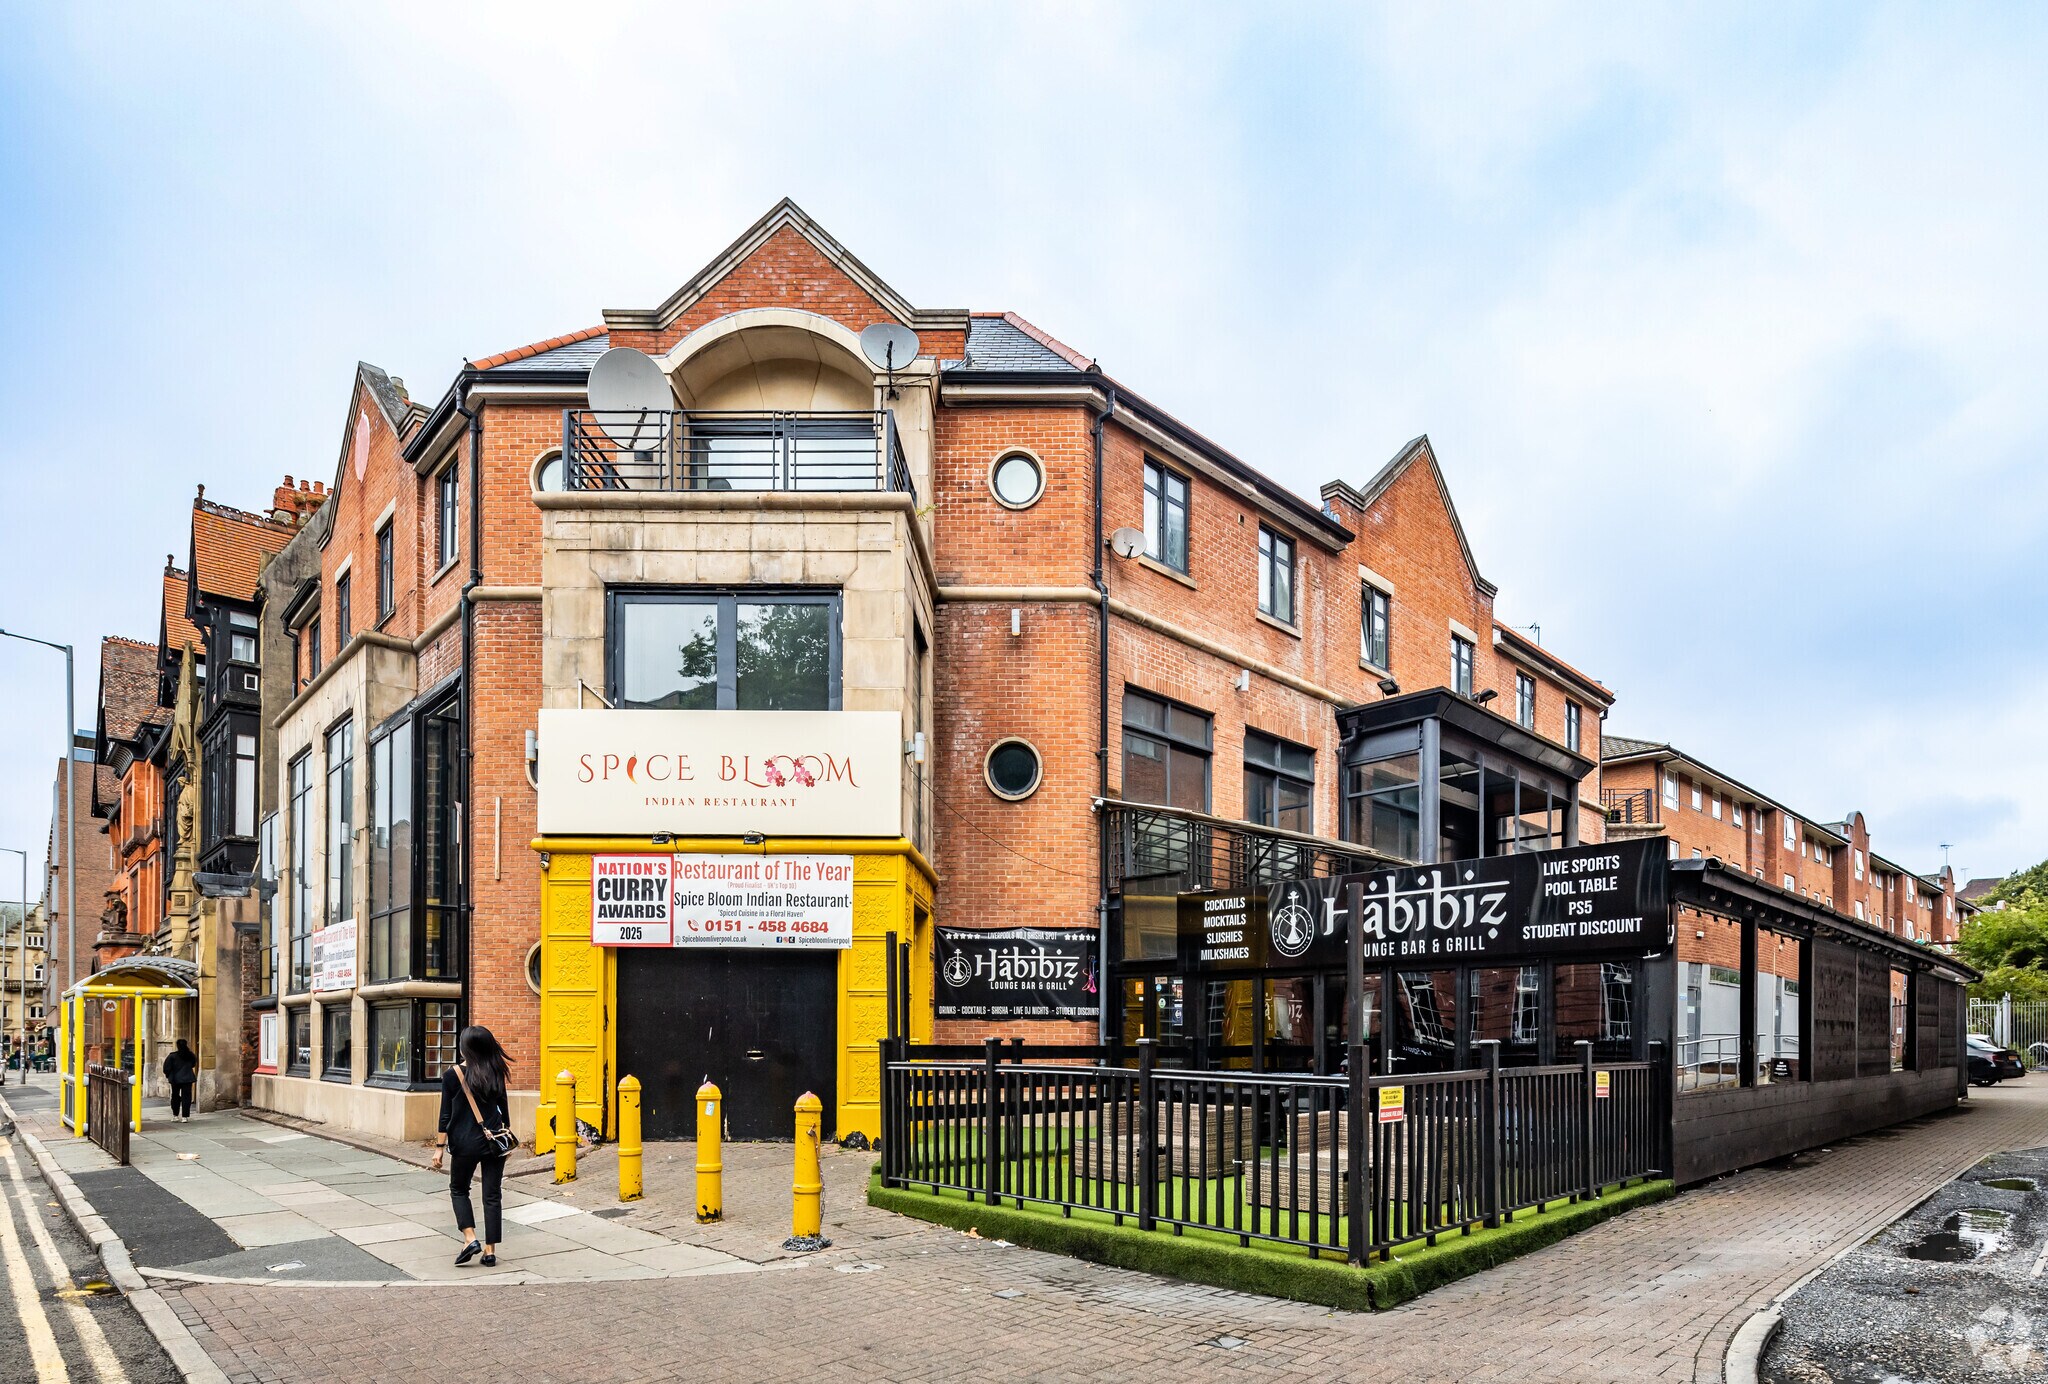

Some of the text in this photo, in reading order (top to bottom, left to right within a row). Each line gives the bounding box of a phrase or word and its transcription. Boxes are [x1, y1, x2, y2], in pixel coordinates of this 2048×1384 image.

[577, 751, 861, 788] SPICE BLOOM
[645, 797, 798, 808] INDIAN RESTAURANT
[598, 862, 667, 876] NATION'S
[674, 860, 852, 882] Restaurant of The Year
[1543, 855, 1620, 877] LIVE SPORTS
[597, 877, 668, 902] CURRY
[1545, 876, 1618, 897] POOL TABLE
[673, 890, 849, 910] Spice Bloom Indian Restaurant
[1204, 896, 1246, 912] COCKTAILS
[1568, 900, 1593, 916] PS5
[597, 904, 667, 919] AWARDS
[738, 909, 758, 917] Cuisine
[758, 909, 765, 917] in
[770, 910, 786, 918] Floral
[704, 920, 742, 932] 0151
[757, 920, 787, 933] 458
[790, 921, 829, 933] 4684
[1203, 913, 1247, 929] MOCKTAILS
[1522, 917, 1643, 940] STUDENT DISCOUNT
[619, 926, 643, 940] 2025
[1045, 931, 1058, 940] SPOT
[1206, 930, 1243, 944] SLUSHIES
[1200, 946, 1250, 961] MILKSHAKES
[1363, 935, 1486, 958] UNGE BAR & GRILL
[974, 946, 1080, 986] Habibiz
[990, 981, 1067, 991] LOUNGE BAR & GRILL
[938, 1005, 957, 1015] DRINKS
[961, 1005, 987, 1015] COCKTAILS
[991, 1005, 1009, 1015] SHISHA
[1013, 1006, 1024, 1015] LIVE
[1024, 1006, 1031, 1015] DJ
[1031, 1006, 1049, 1015] NIGHTS
[1055, 1006, 1077, 1016] STUDENT
[1077, 1007, 1100, 1016] DISCOUNTS
